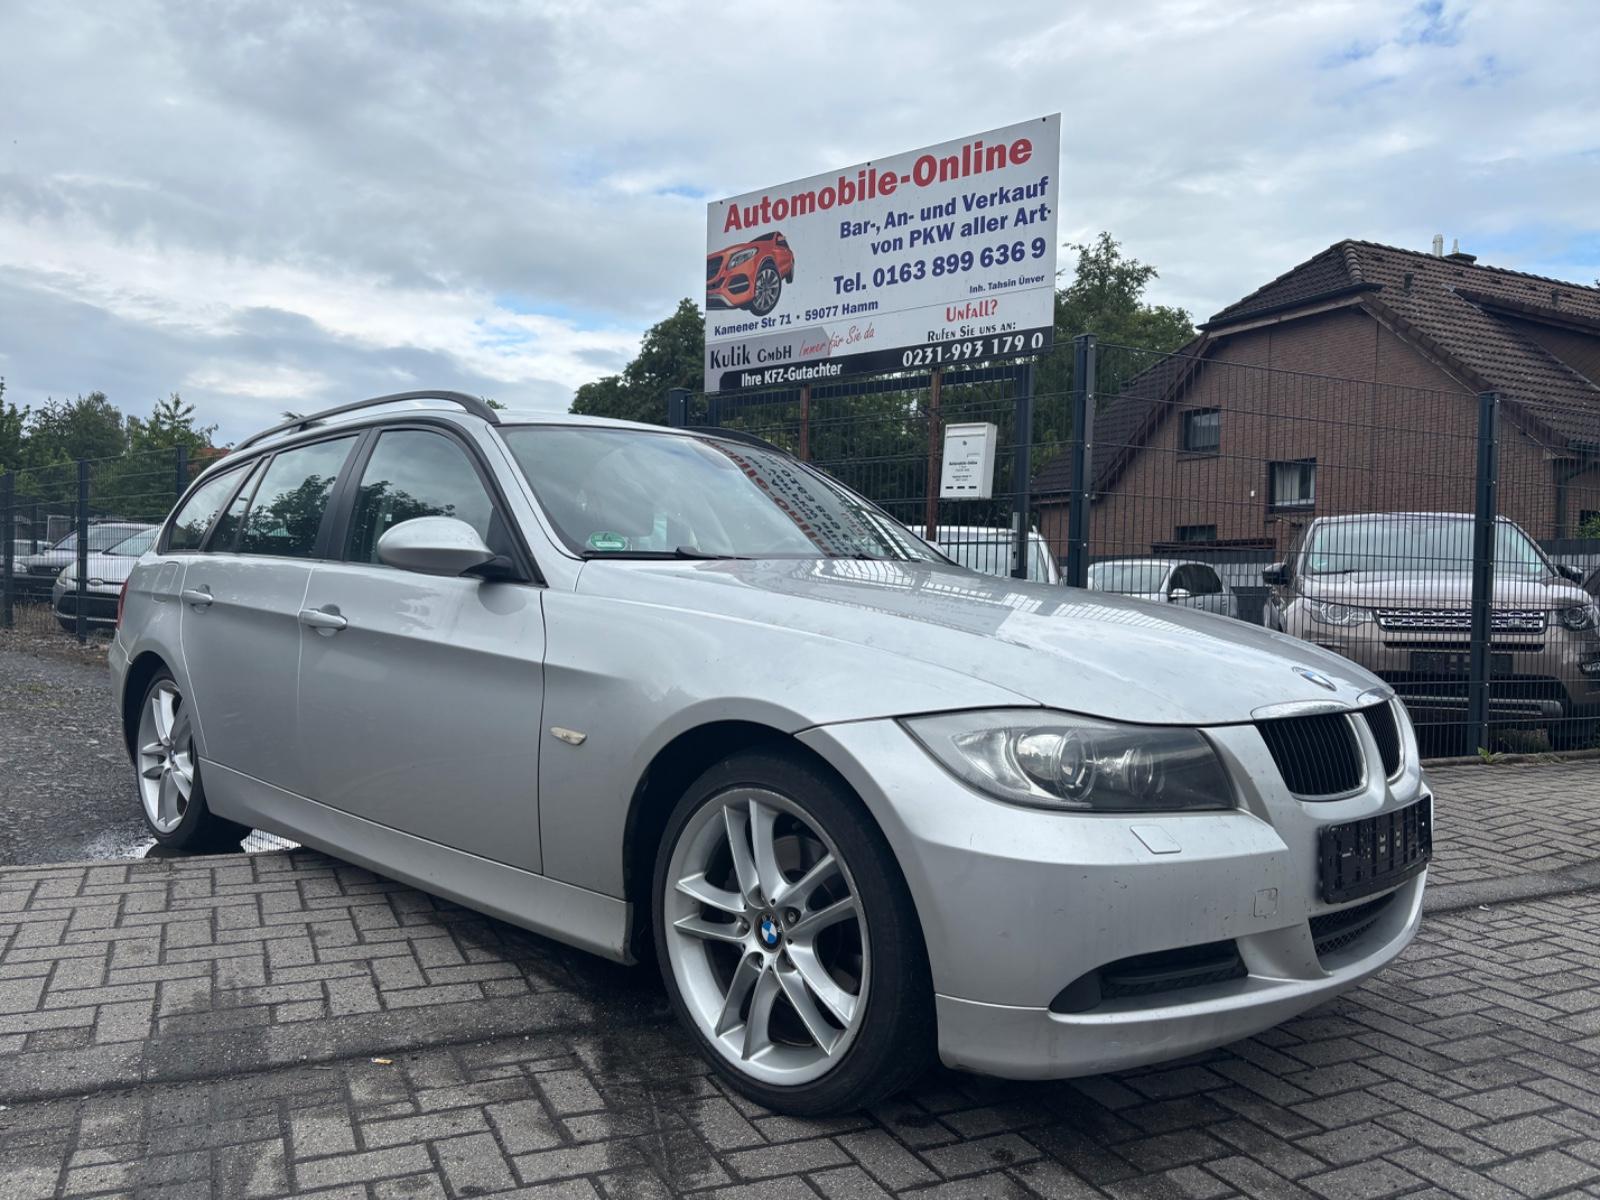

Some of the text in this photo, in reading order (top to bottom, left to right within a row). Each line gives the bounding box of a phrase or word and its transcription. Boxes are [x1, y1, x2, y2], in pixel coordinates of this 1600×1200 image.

[724, 138, 1032, 233] Automobile-Online
[840, 176, 1049, 238] Bar-, An- und Verkauf
[871, 237, 903, 255] von
[909, 222, 955, 248] PKW
[960, 215, 1008, 238] aller
[833, 272, 867, 294] Tel.
[873, 260, 926, 288] 0163
[931, 250, 974, 277] 899
[970, 274, 1045, 294] Inh. Tahsin Ünver
[714, 300, 878, 336] Kamener Str 71 59077 Hamm
[960, 325, 975, 337] Sie
[710, 344, 750, 369] Kulik
[757, 345, 792, 363] GmbH
[846, 325, 861, 345] Sie
[991, 334, 1025, 355] 179
[1031, 332, 1044, 349] 0
[741, 362, 843, 387] Ihre KFZ-Gutachter
